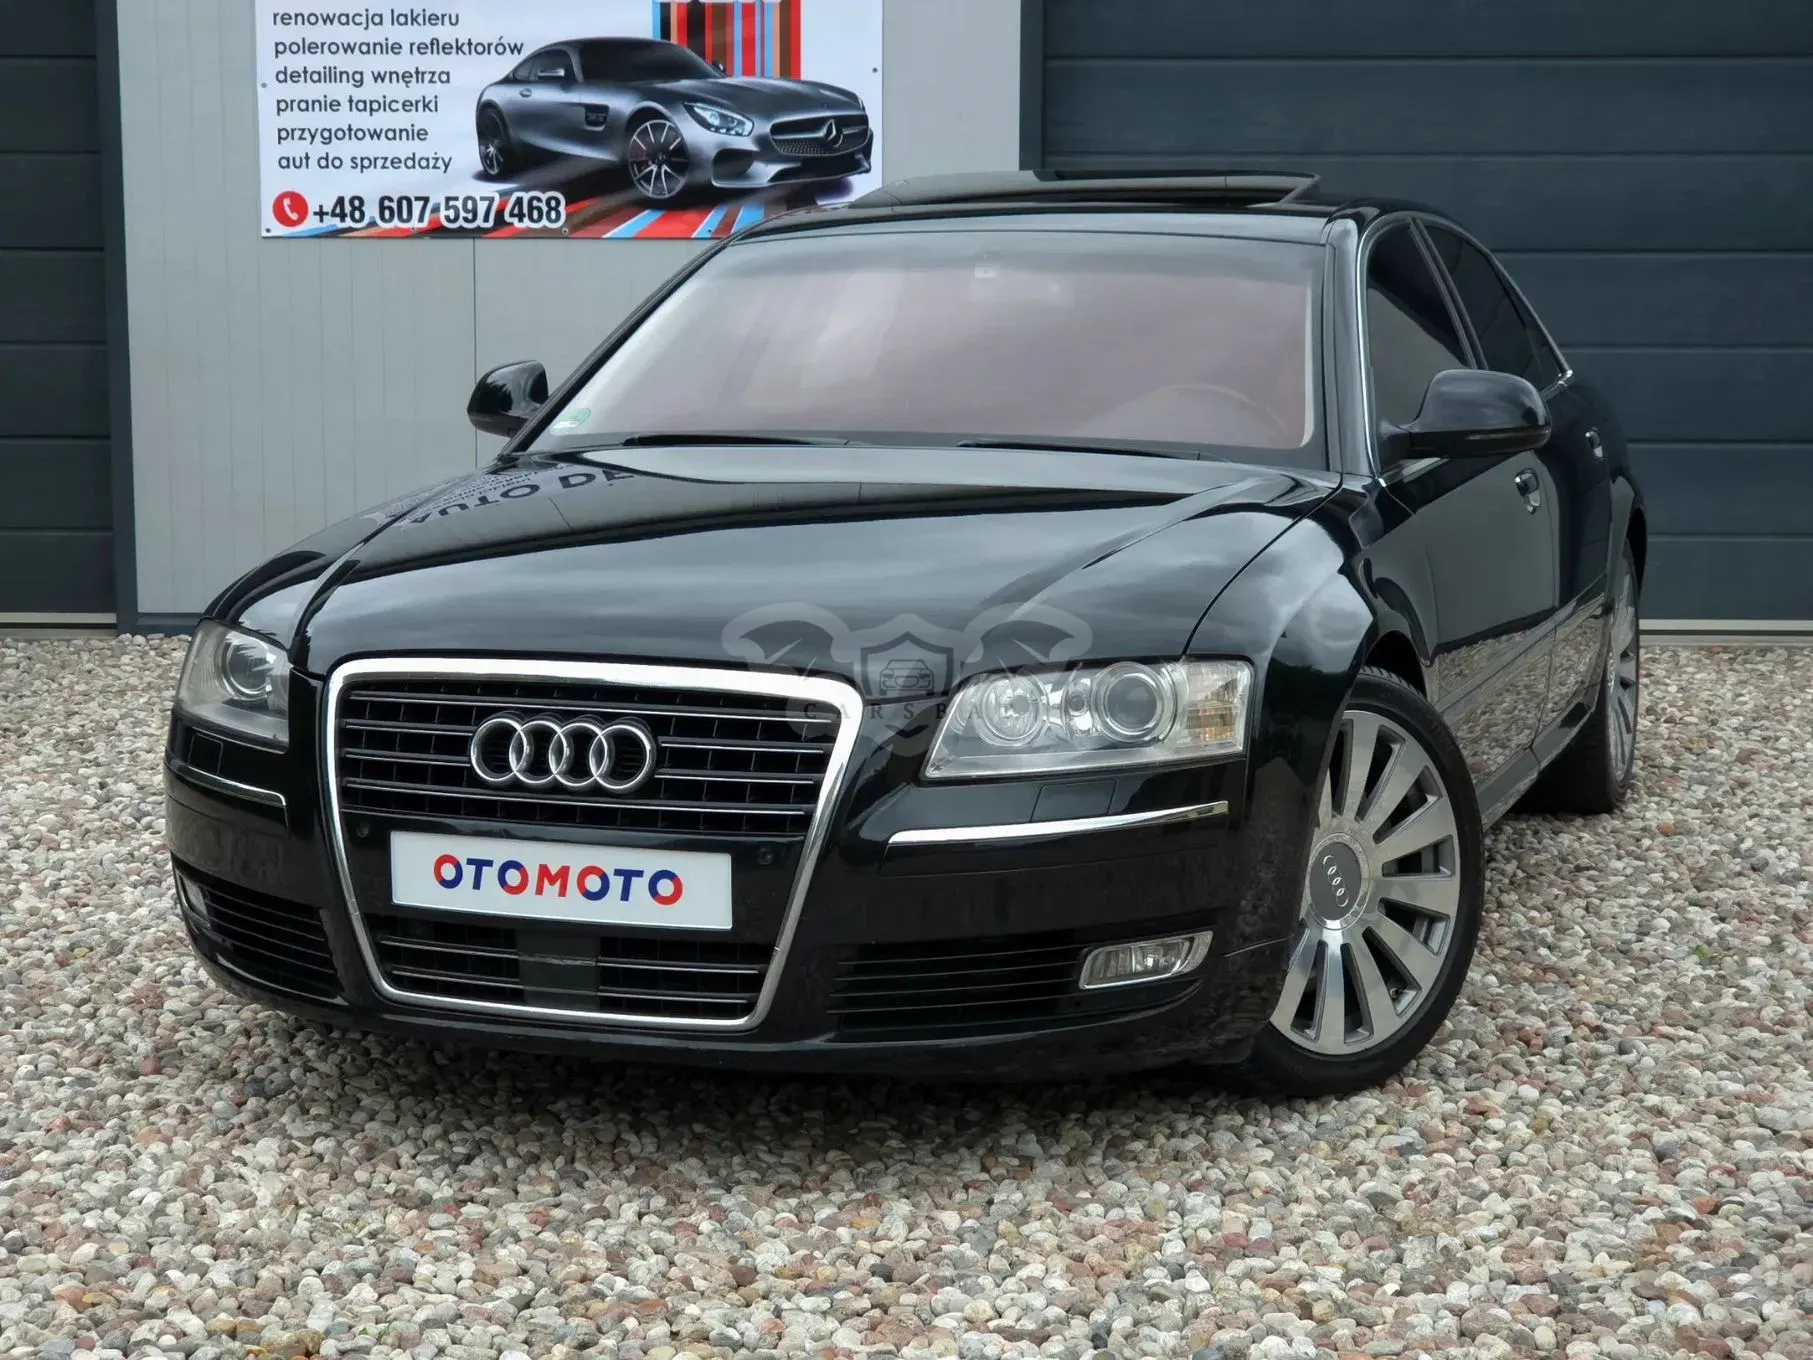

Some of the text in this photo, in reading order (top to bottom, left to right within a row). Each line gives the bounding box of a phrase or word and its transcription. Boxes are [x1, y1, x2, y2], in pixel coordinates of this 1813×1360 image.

[273, 8, 460, 30] renowacja lakieru
[275, 36, 524, 59] polerowanie reflektorów
[276, 66, 450, 88] detailing wnętrza
[277, 95, 438, 116] pranie tapicerki
[278, 124, 428, 145] przygotowanie
[278, 152, 452, 174] aut do sprzedaży
[313, 195, 562, 225] +48 607 597 468
[433, 854, 684, 906] OTOMOTO
